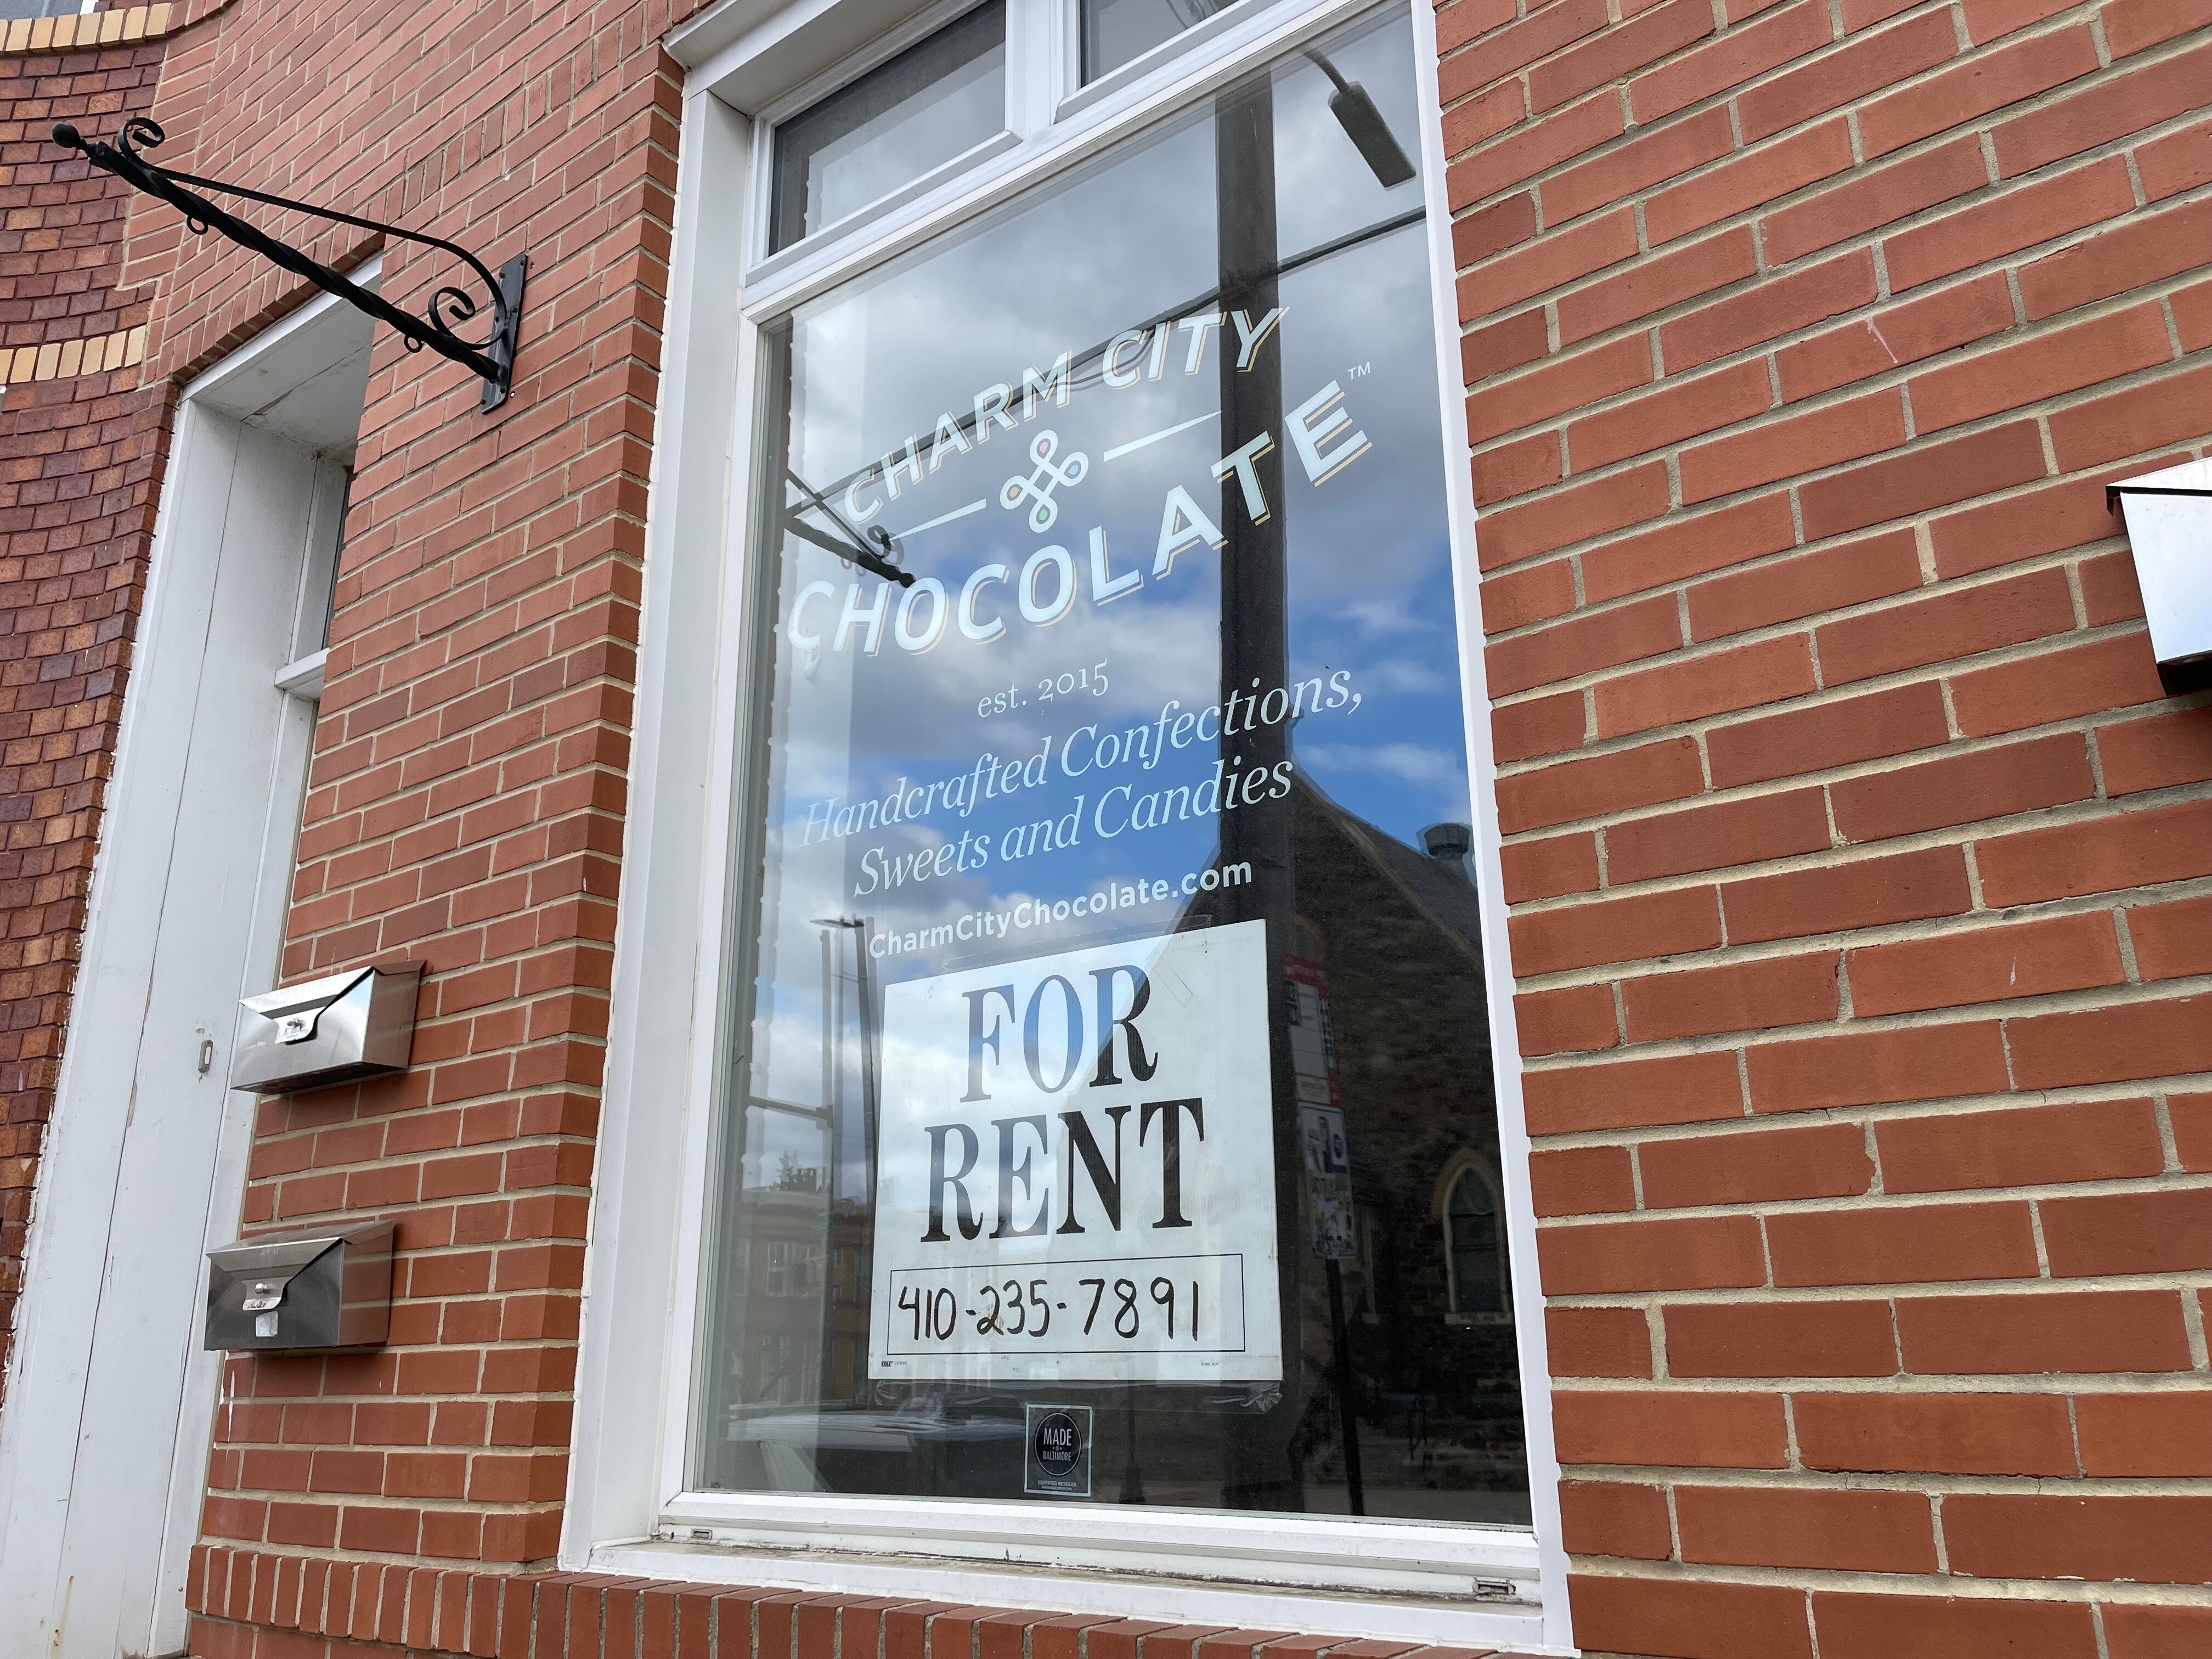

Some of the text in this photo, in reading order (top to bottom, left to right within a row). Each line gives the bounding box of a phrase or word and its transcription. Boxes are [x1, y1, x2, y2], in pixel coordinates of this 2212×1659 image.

[844, 307, 1290, 525] CHARM CITY
[787, 361, 1373, 657] CHOCOLATE TM
[798, 667, 1363, 848] Handcrafted Confections,
[978, 659, 1109, 718] est. 2015
[854, 757, 1294, 898] Sweets and Candies
[869, 858, 1252, 958] CharmCityChocolate.com
[960, 964, 1159, 1104] FOR
[920, 1097, 1205, 1243] RENT
[898, 1276, 1199, 1341] 410-235-7891
[1042, 1451, 1071, 1462] BALTIMORE
[1043, 1427, 1072, 1446] MADE
